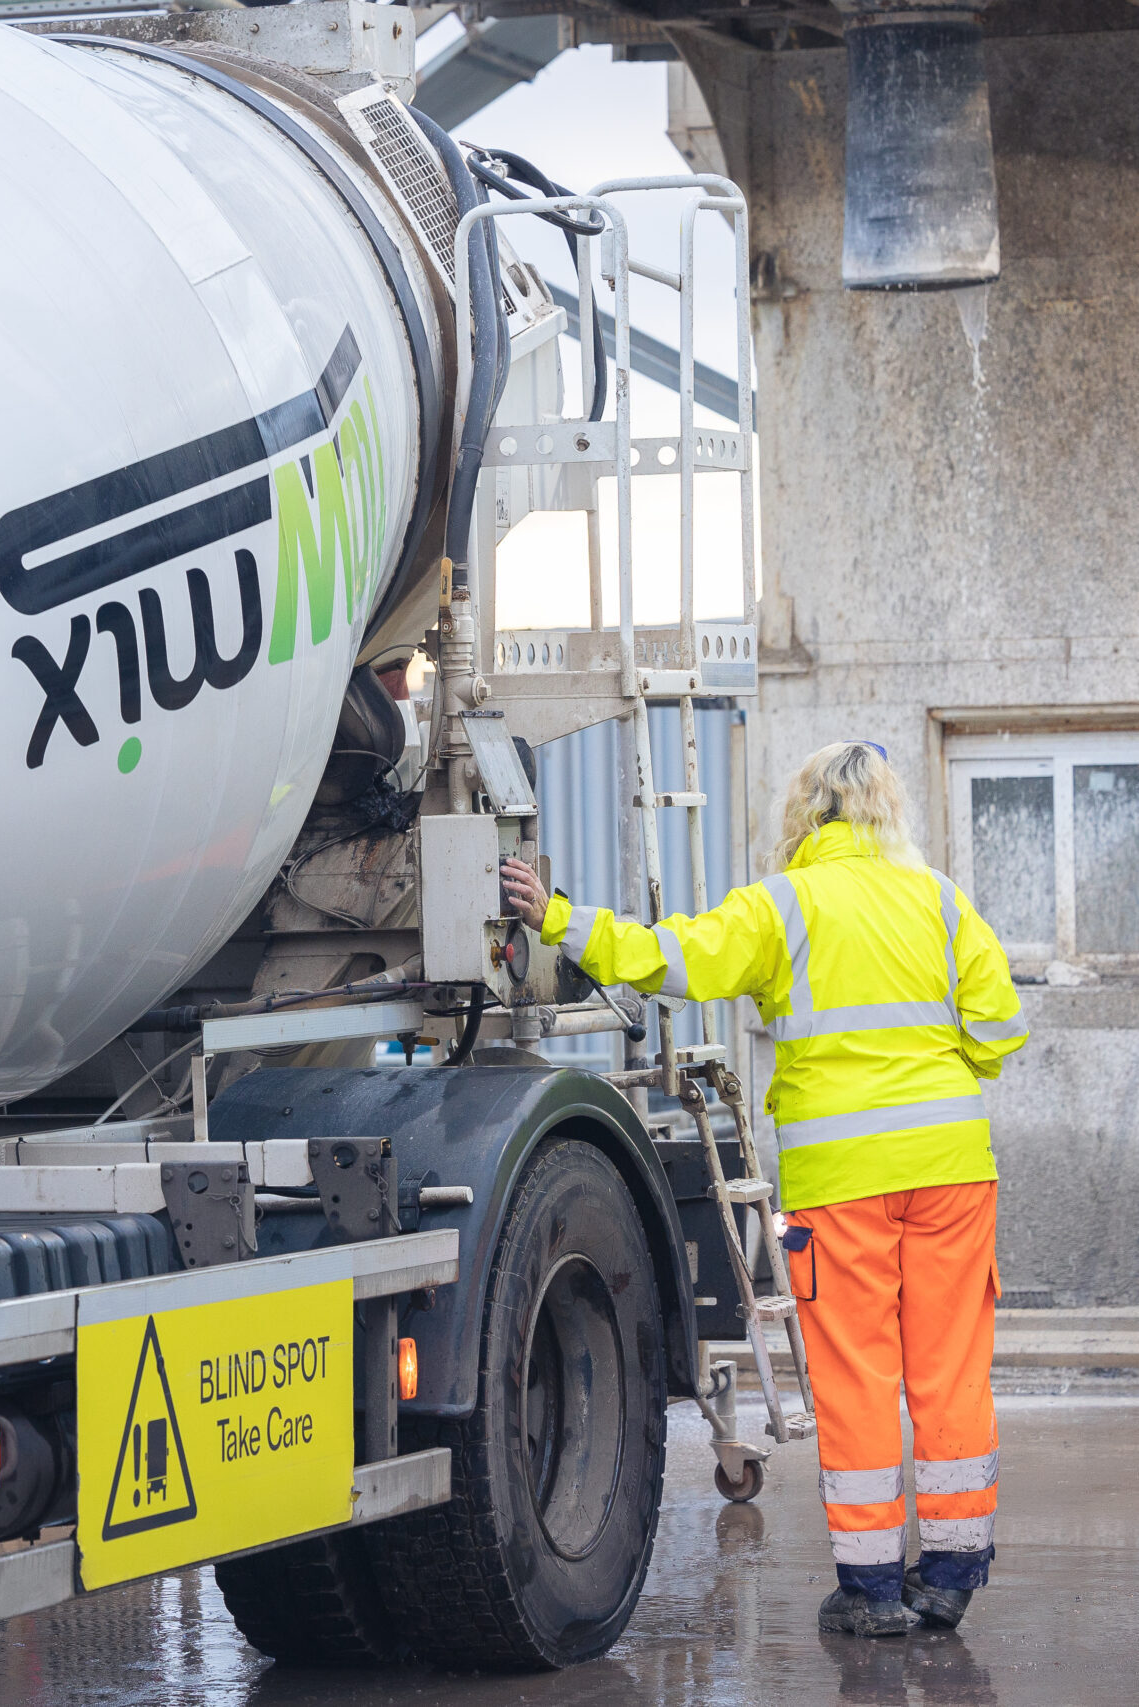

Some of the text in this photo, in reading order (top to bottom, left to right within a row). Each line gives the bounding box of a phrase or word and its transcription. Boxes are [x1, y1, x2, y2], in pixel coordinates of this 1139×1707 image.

[200, 1336, 330, 1404] BLIND SPOT
[217, 1406, 313, 1463] Take Care
